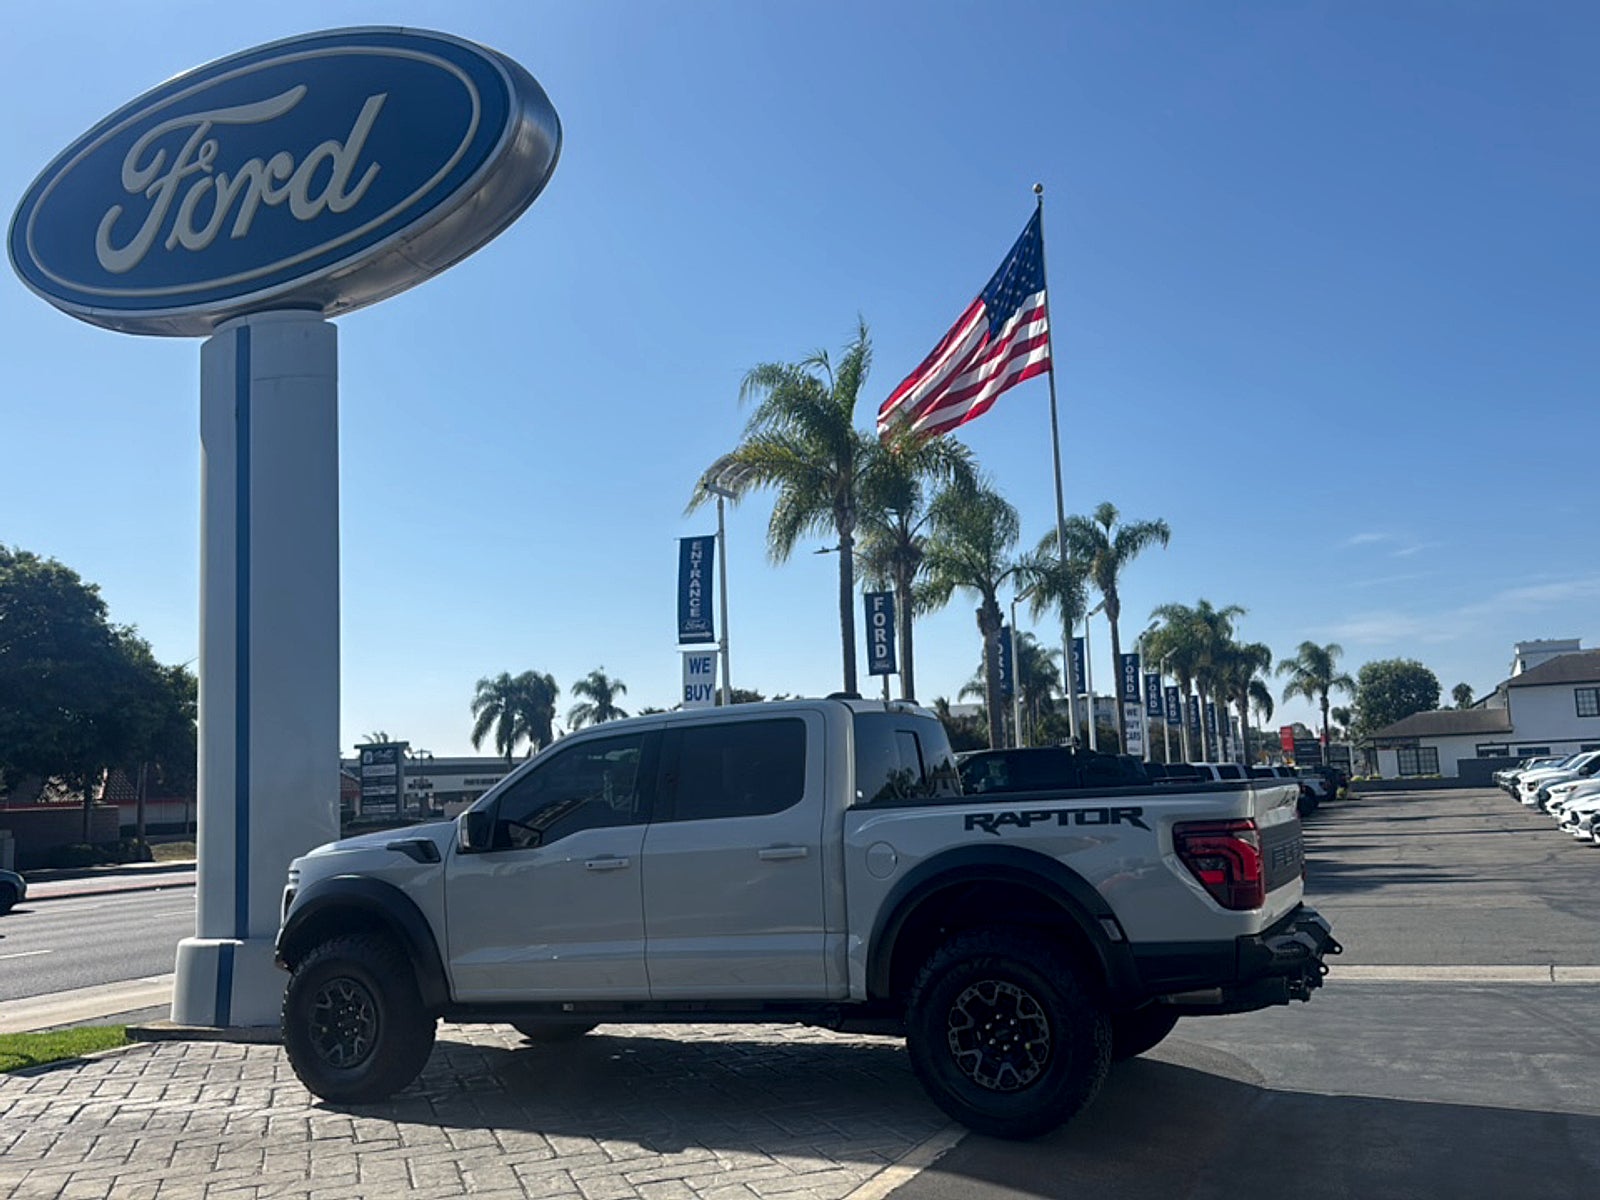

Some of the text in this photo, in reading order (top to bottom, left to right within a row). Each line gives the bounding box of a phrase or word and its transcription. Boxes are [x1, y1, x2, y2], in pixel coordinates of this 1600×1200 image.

[95, 84, 388, 273] Ford
[689, 541, 702, 617] ENTRANCE
[873, 597, 887, 658] FORD
[690, 657, 711, 674] WE
[1125, 656, 1135, 693] FORD
[685, 684, 712, 700] BUY
[1149, 675, 1157, 708] FORD
[964, 807, 1151, 836] RAPTOR
